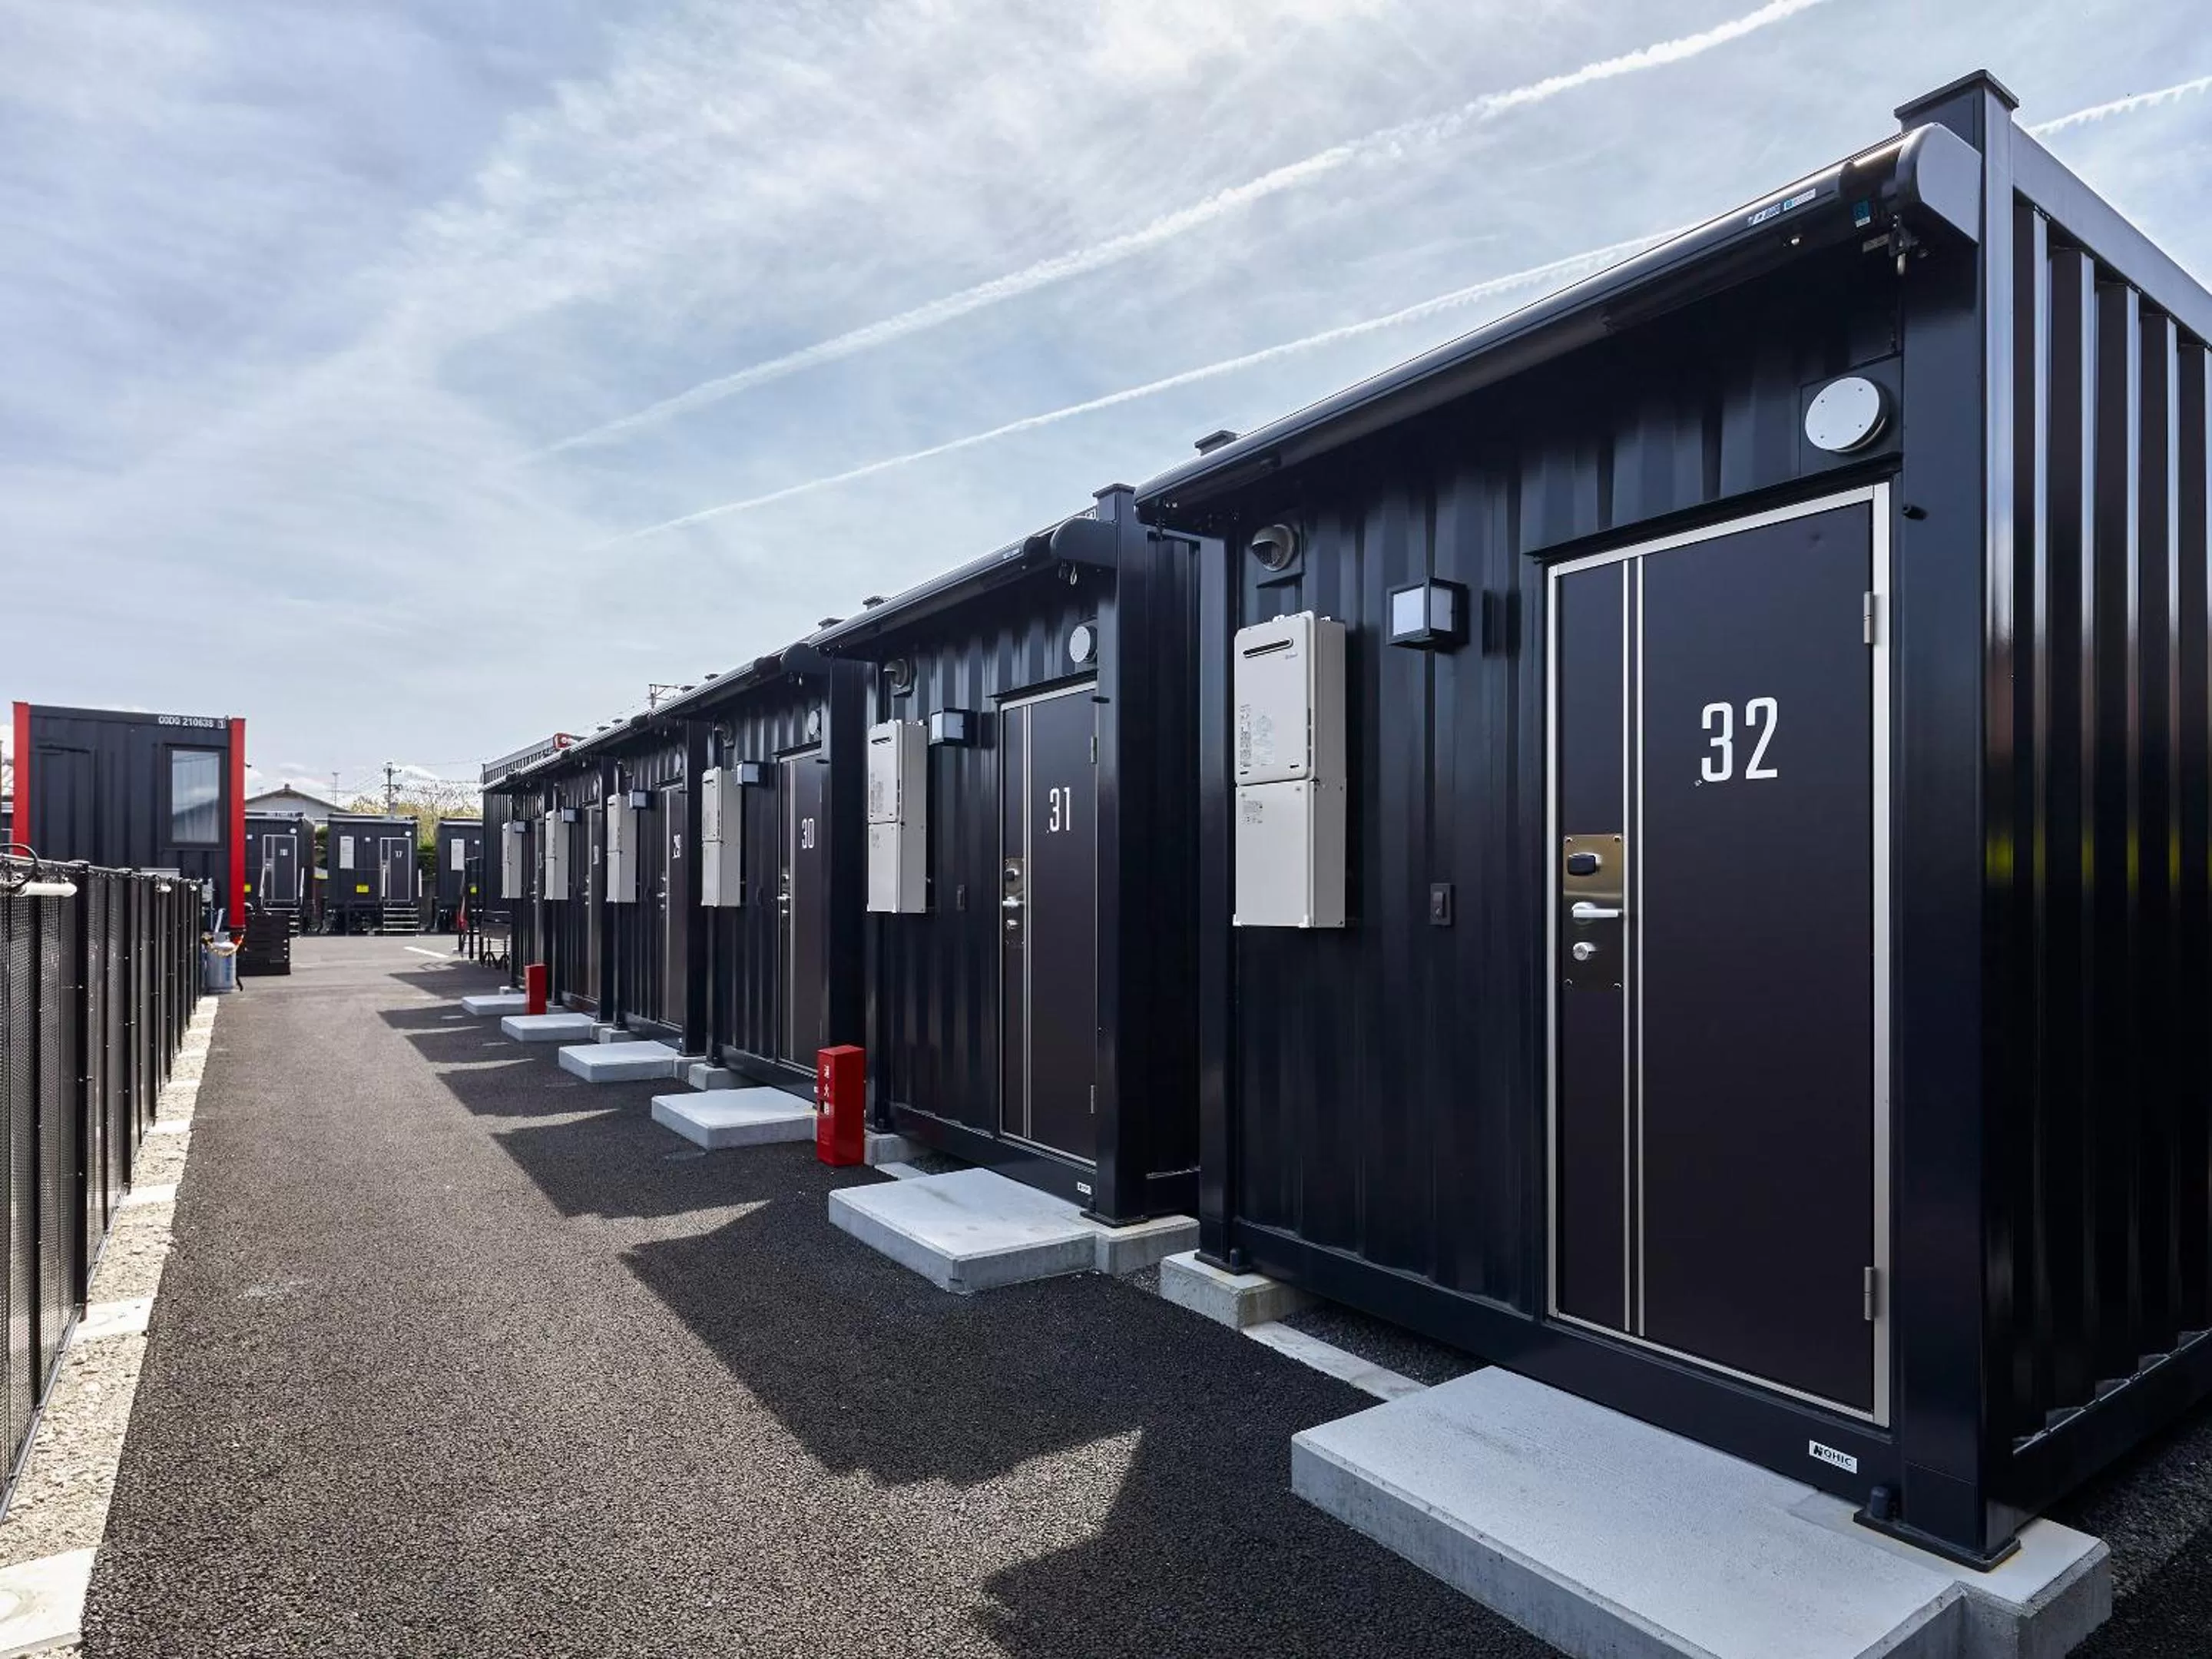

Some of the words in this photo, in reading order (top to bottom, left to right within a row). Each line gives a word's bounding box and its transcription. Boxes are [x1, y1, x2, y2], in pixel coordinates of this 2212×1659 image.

[1701, 697, 1777, 782] 32
[1049, 786, 1070, 832] 31
[801, 818, 814, 849] 30
